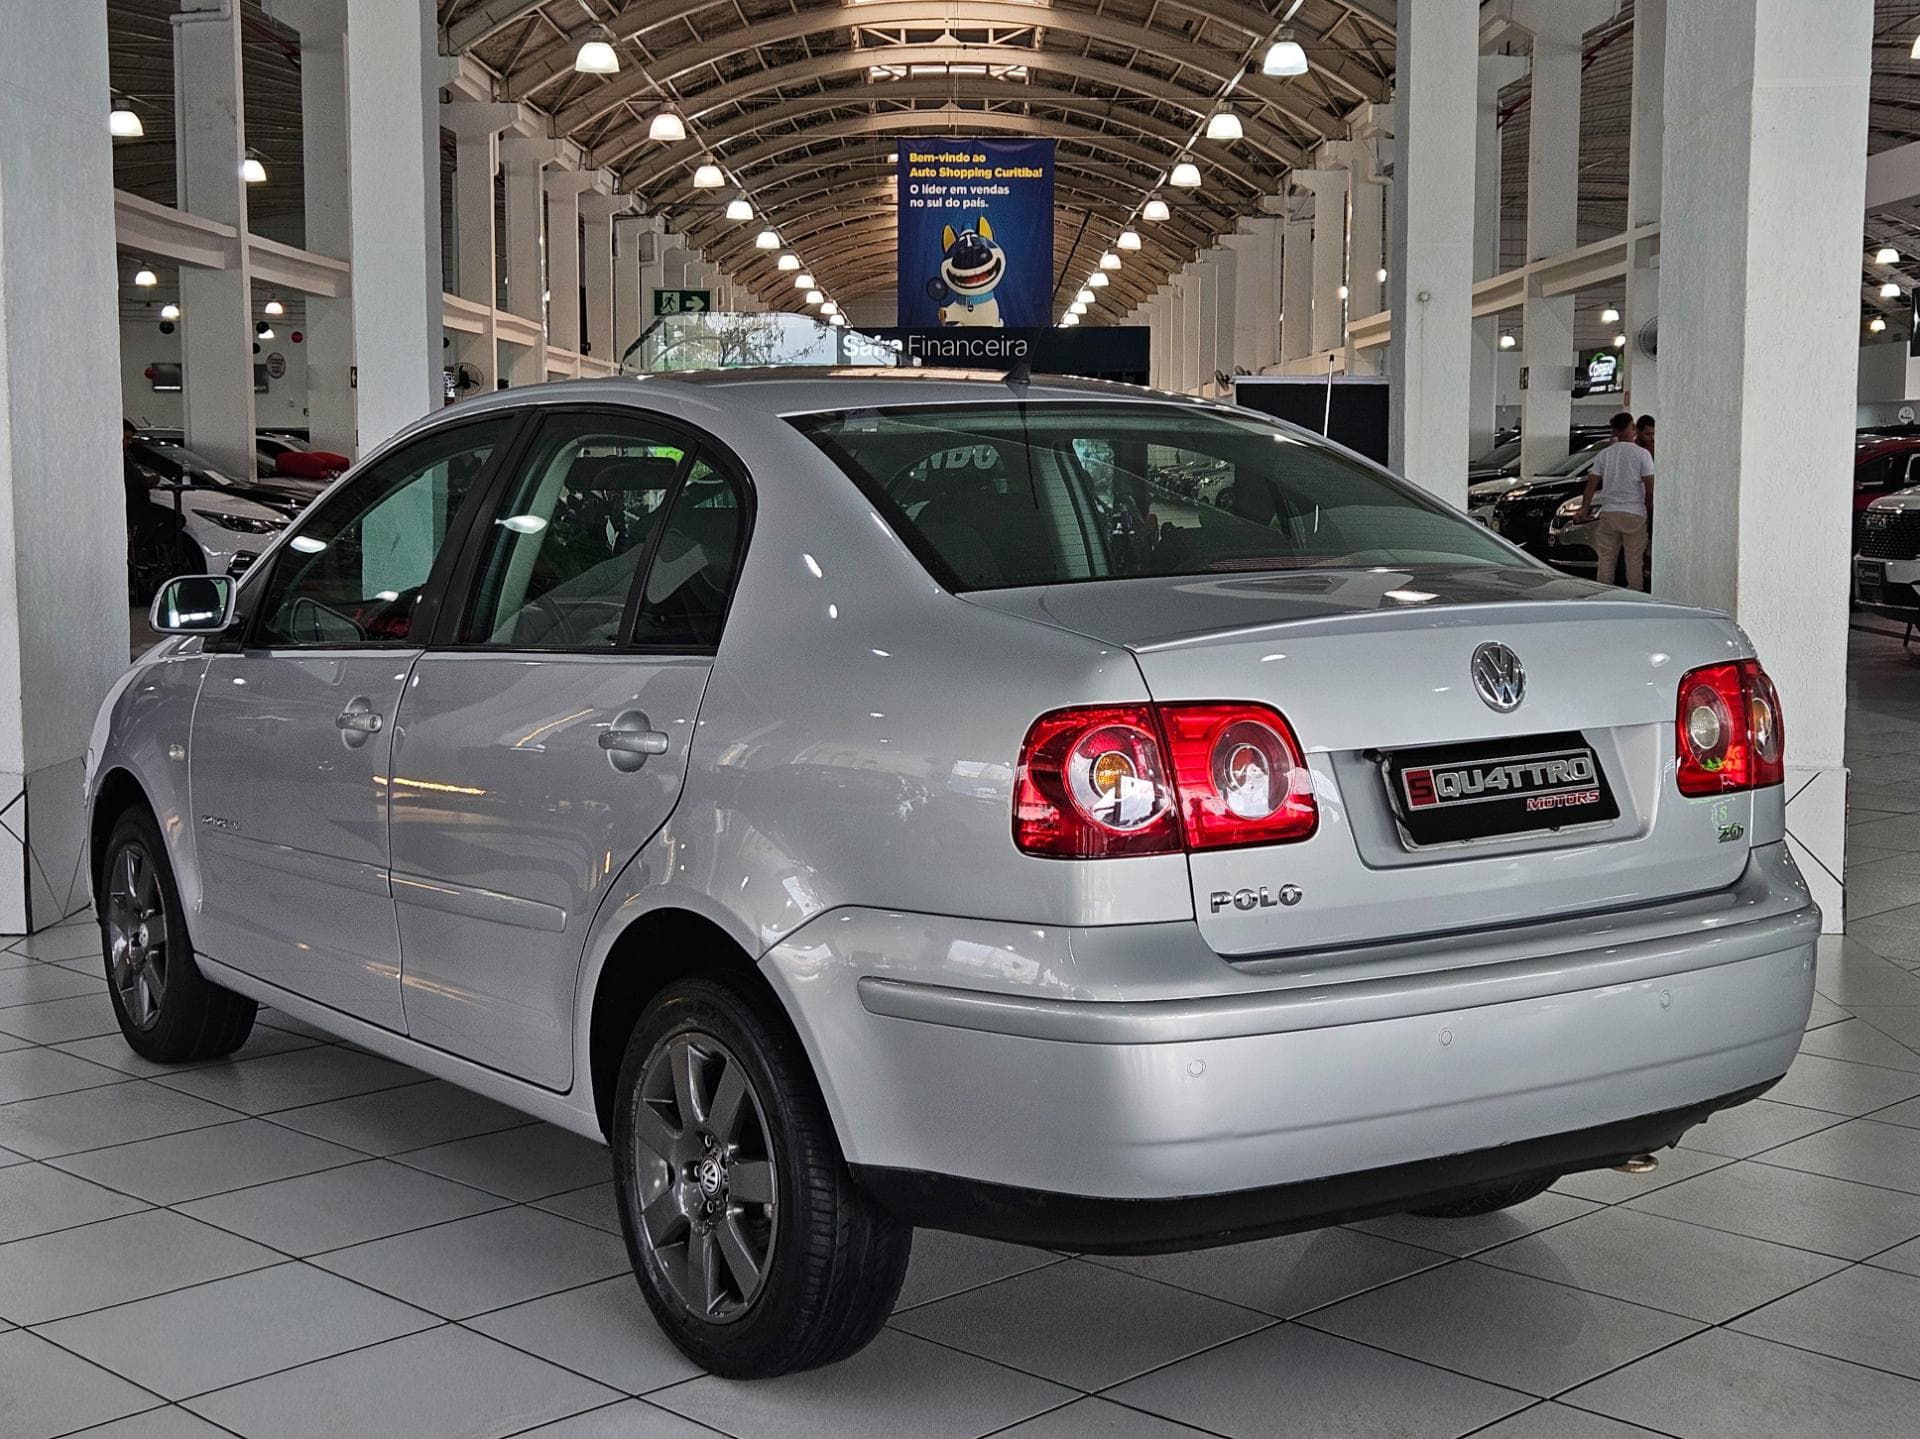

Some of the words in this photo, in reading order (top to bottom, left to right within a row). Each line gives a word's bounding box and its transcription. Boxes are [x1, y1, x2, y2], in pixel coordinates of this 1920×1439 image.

[909, 152, 970, 163] Bem-vindo
[972, 154, 986, 163] ao
[909, 168, 936, 177] Auto
[939, 167, 992, 179] Shopping
[995, 167, 1043, 178] Curitiba!
[910, 184, 919, 194] O
[922, 184, 947, 194] líder
[970, 184, 1010, 194] vendas
[927, 198, 942, 207] sul
[945, 198, 960, 207] do
[963, 198, 989, 209] país.
[908, 335, 1028, 357] Financeira
[1436, 758, 1593, 797] QU4TTRO
[1526, 791, 1600, 811] MOTORS
[1210, 883, 1303, 914] POLO
